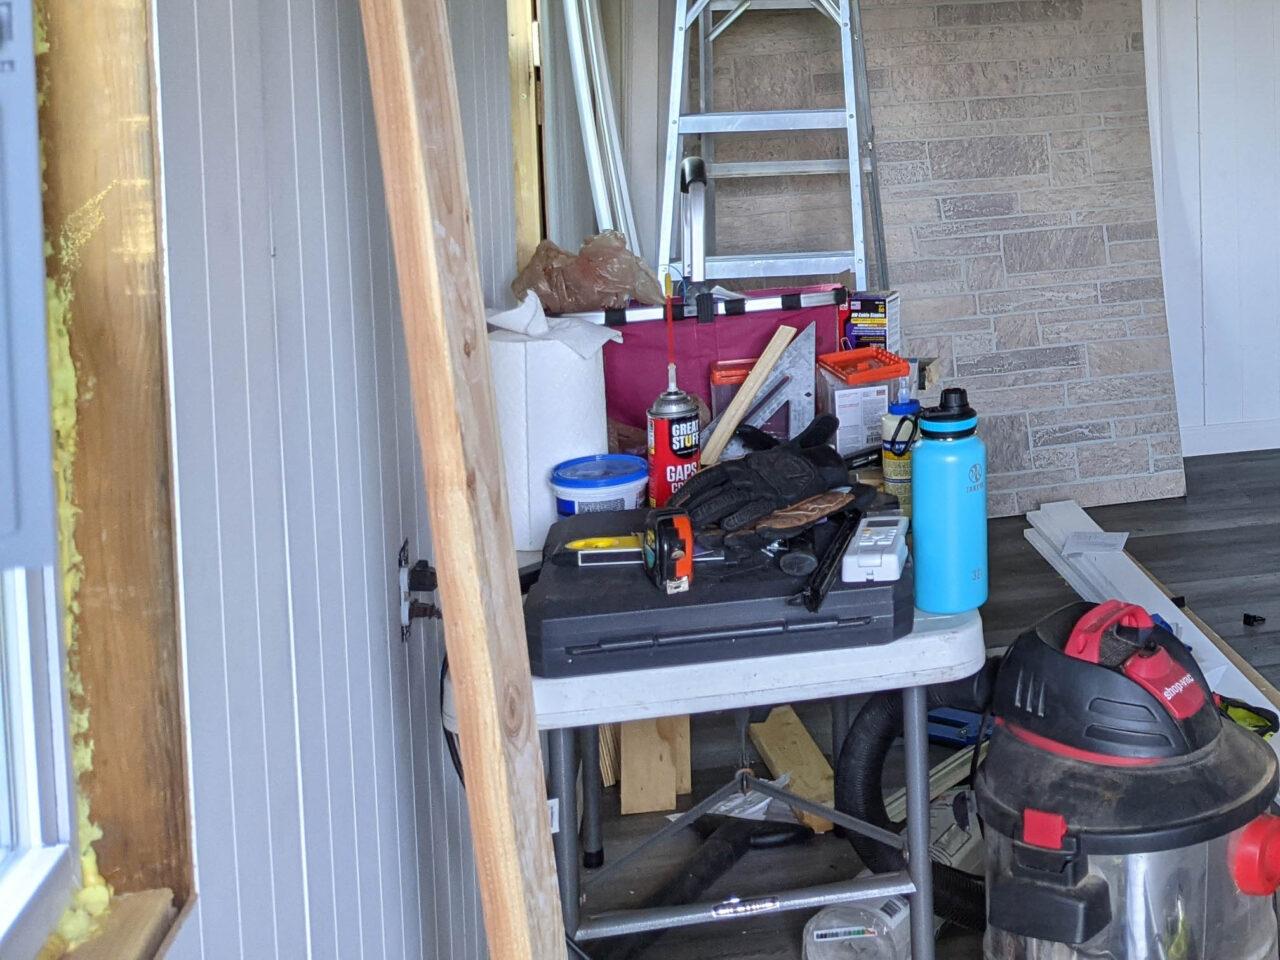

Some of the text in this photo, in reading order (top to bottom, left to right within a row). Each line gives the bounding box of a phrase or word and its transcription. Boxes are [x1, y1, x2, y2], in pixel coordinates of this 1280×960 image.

[671, 420, 699, 437] GREAT
[672, 431, 700, 450] STUFF
[666, 461, 698, 483] GAPS
